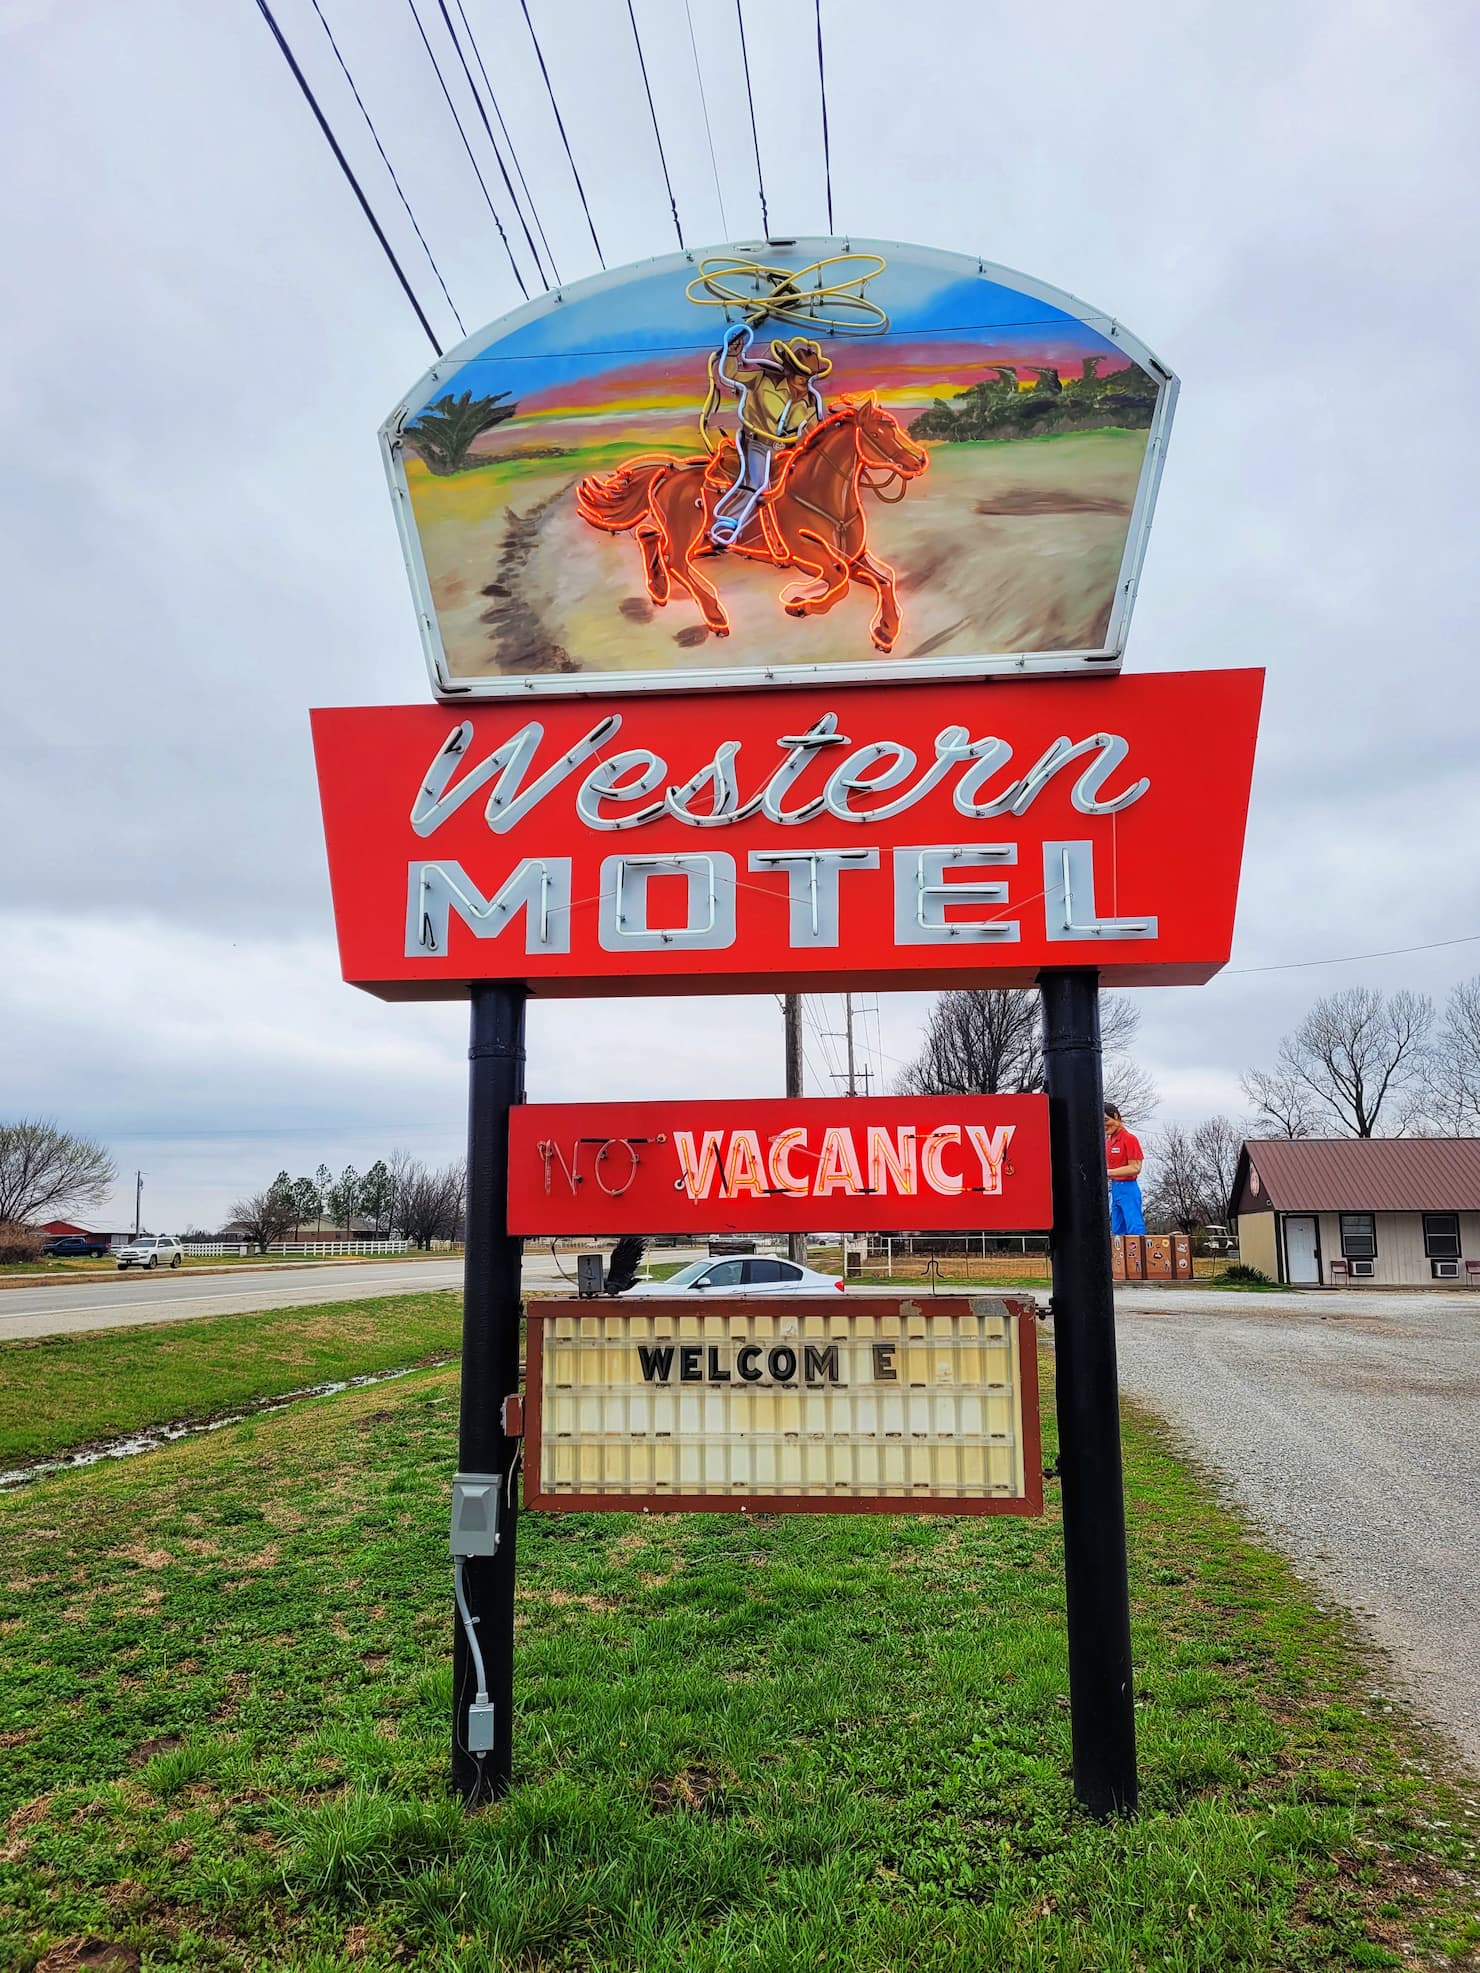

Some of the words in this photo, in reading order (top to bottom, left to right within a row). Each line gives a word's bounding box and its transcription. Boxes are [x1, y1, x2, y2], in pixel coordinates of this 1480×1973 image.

[409, 712, 1151, 838] Western
[404, 838, 1158, 958] MOTEL
[540, 1138, 638, 1196] NO
[673, 1124, 1016, 1199] VACANCY
